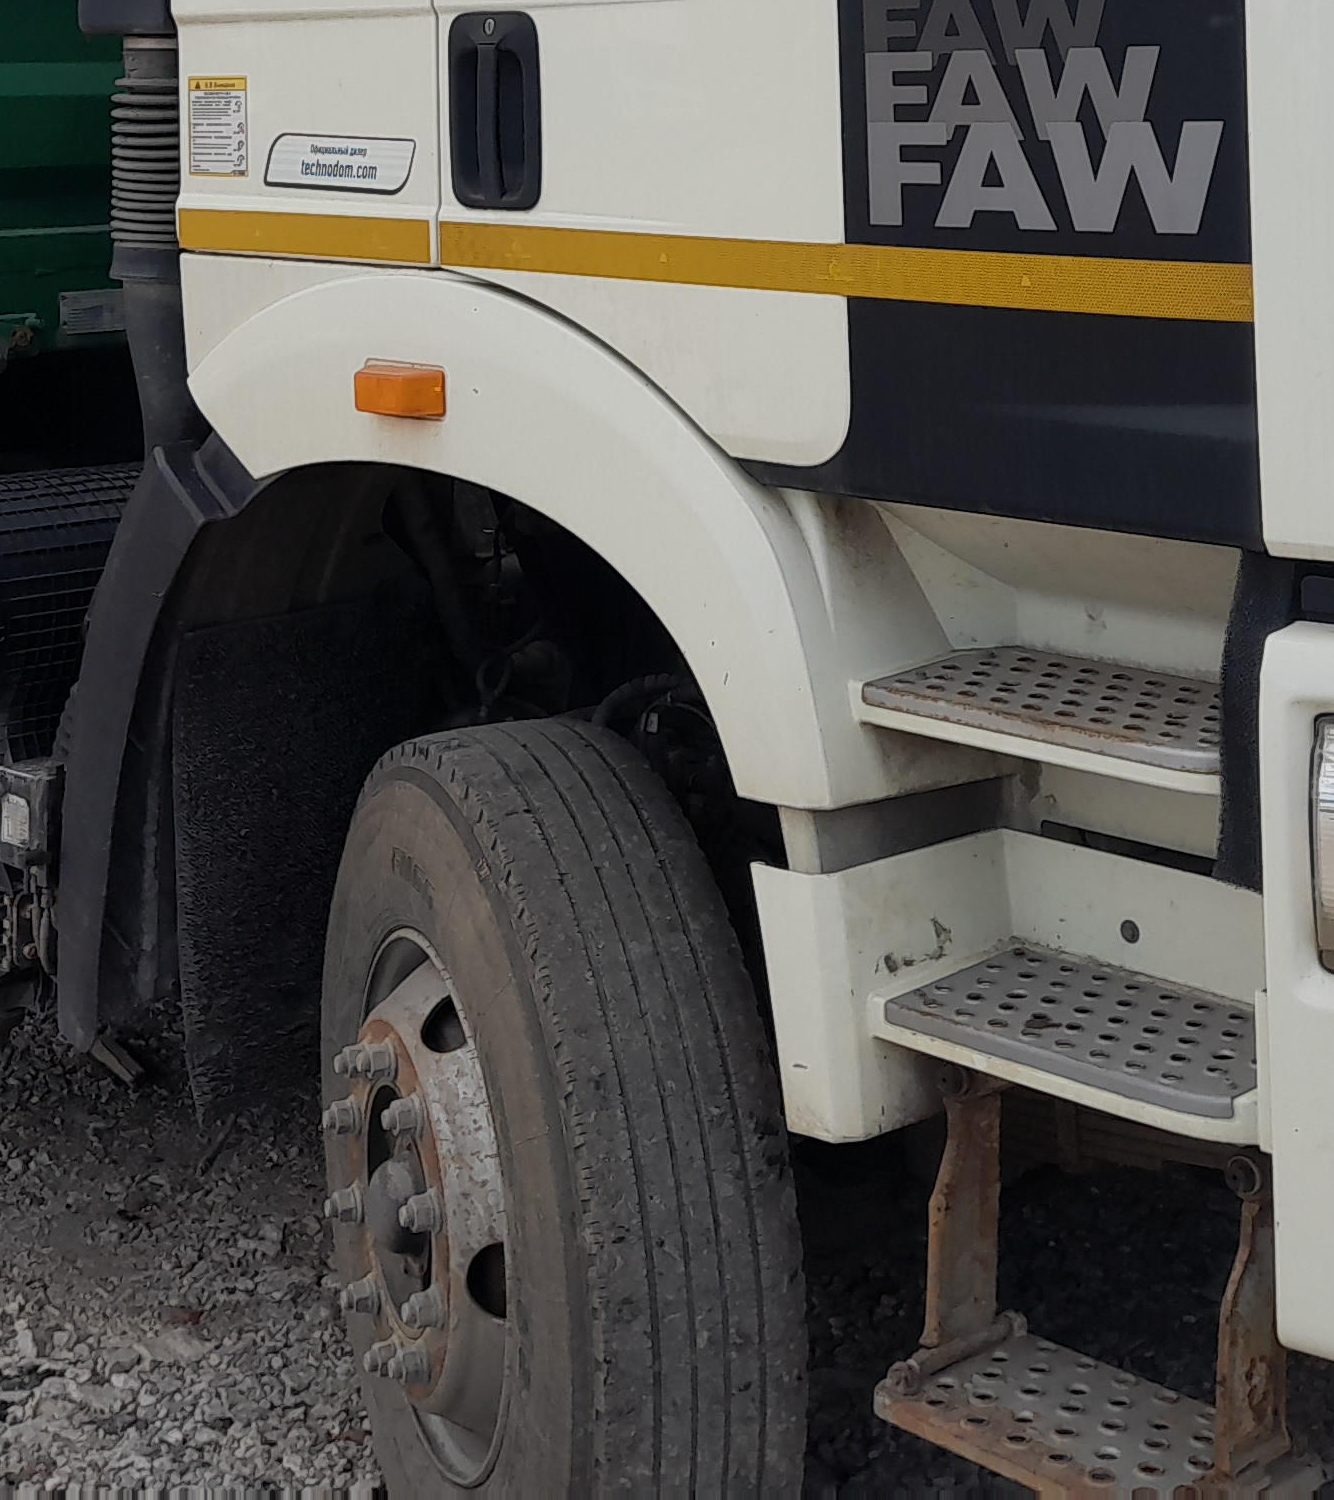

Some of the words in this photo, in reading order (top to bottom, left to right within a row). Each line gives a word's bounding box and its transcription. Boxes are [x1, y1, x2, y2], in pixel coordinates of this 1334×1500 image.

[864, 44, 1162, 141] FAW
[300, 158, 378, 181] technodom.com
[868, 120, 1226, 235] FAW
